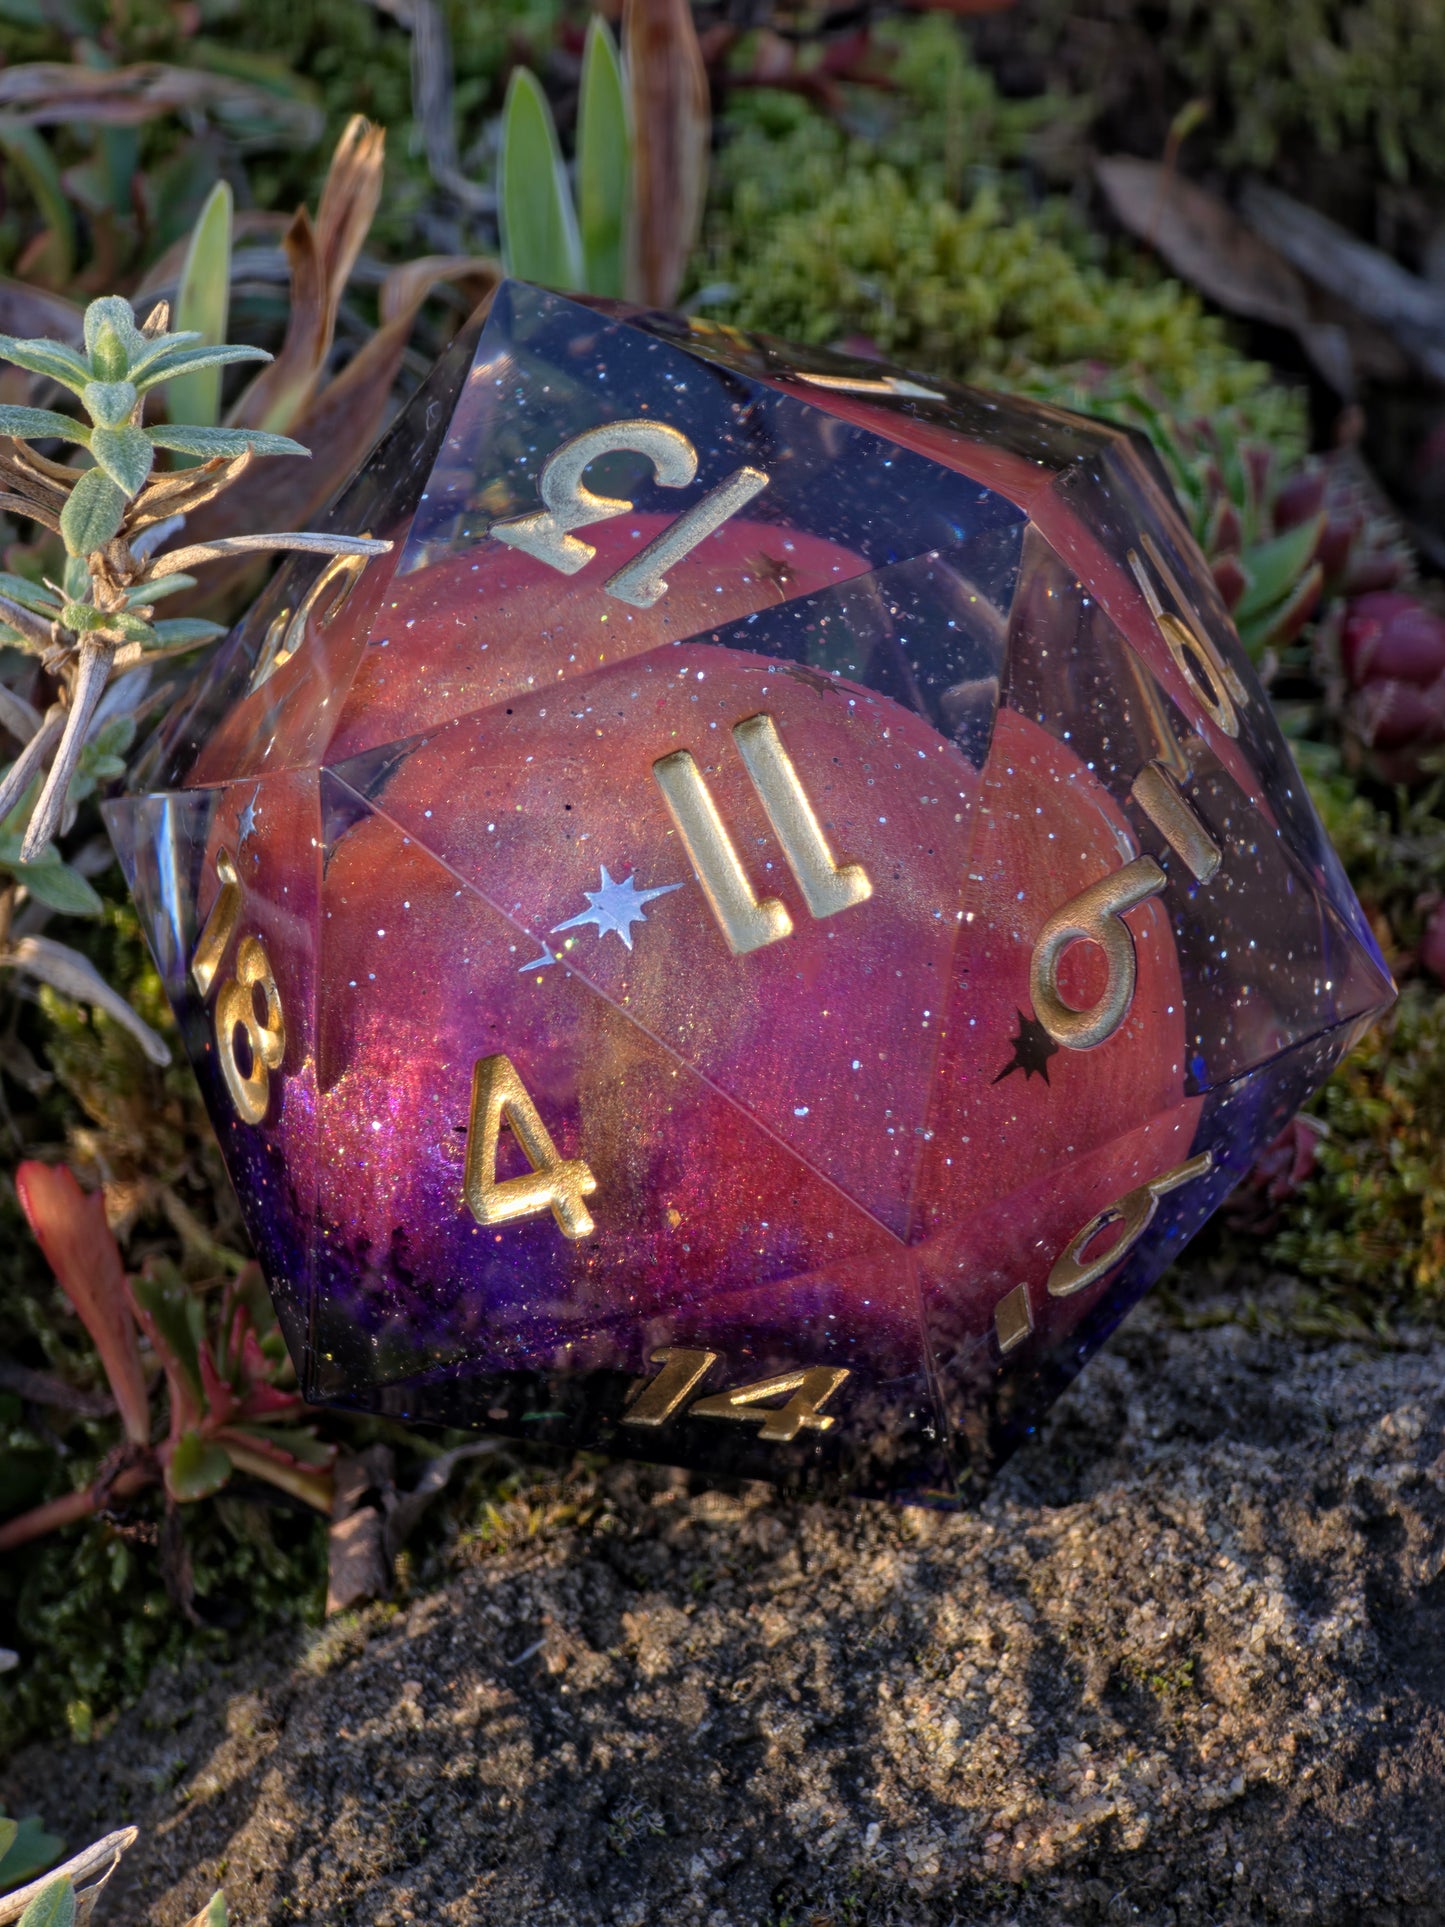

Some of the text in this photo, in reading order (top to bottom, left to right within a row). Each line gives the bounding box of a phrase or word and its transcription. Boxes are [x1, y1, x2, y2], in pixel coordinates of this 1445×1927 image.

[486, 418, 770, 609] 13
[652, 712, 874, 956] 11
[191, 845, 286, 1125] 18
[463, 1052, 598, 1238] 4
[619, 1346, 850, 1441] 14
